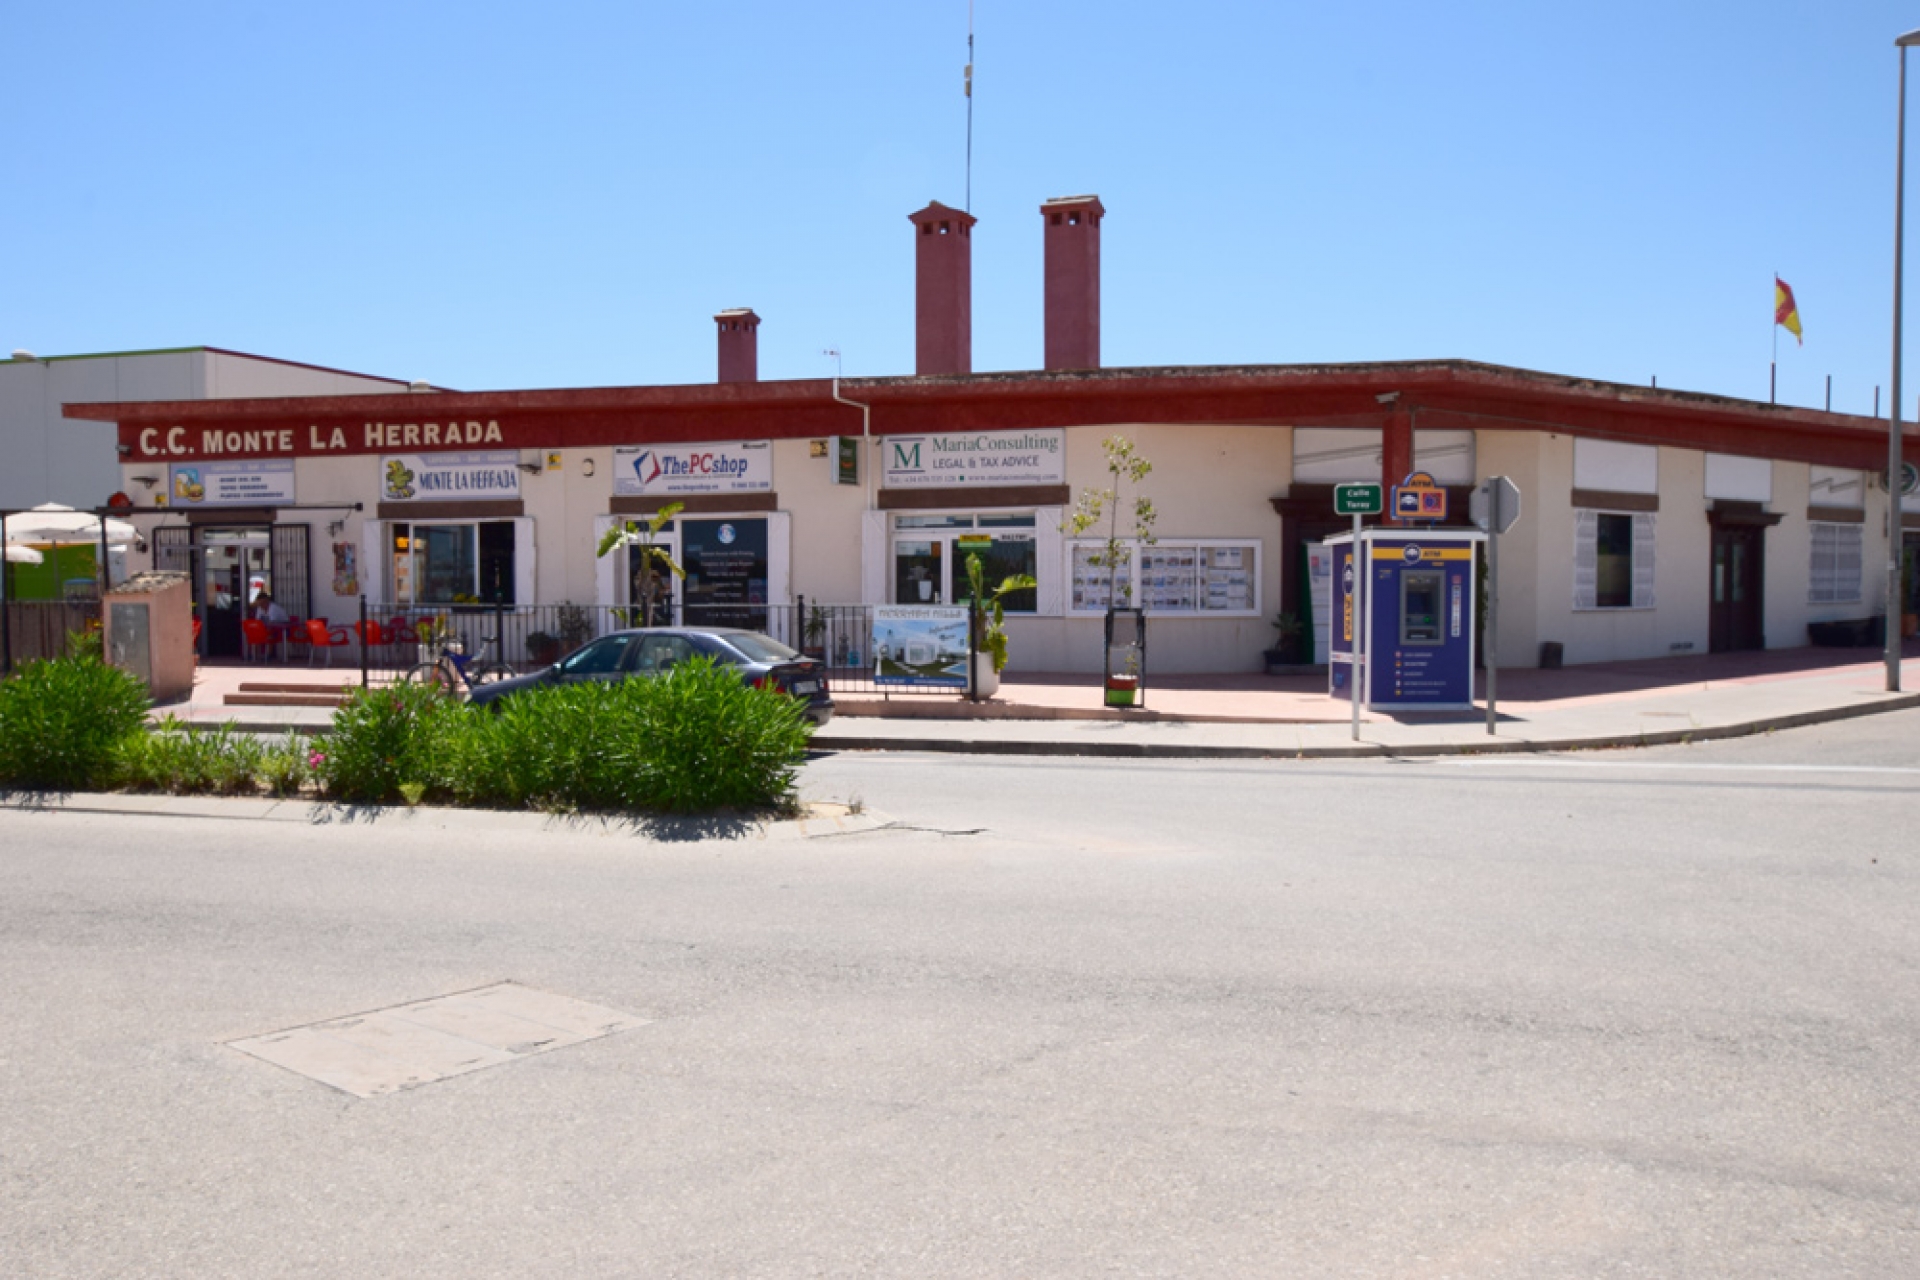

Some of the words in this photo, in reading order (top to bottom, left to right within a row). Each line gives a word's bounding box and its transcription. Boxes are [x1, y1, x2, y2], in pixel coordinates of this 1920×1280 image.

[139, 426, 194, 456] C.C.
[202, 429, 294, 454] MONTE
[310, 424, 347, 449] LA
[364, 419, 504, 448] HERRADA
[932, 434, 1059, 453] MariaConsulting
[662, 452, 748, 478] ThePCshop
[892, 442, 922, 469] M
[932, 457, 965, 469] LEGAL
[968, 456, 976, 468] &
[980, 456, 998, 468] TAX
[1001, 454, 1040, 468] ADVICE
[1347, 489, 1370, 497] Calle
